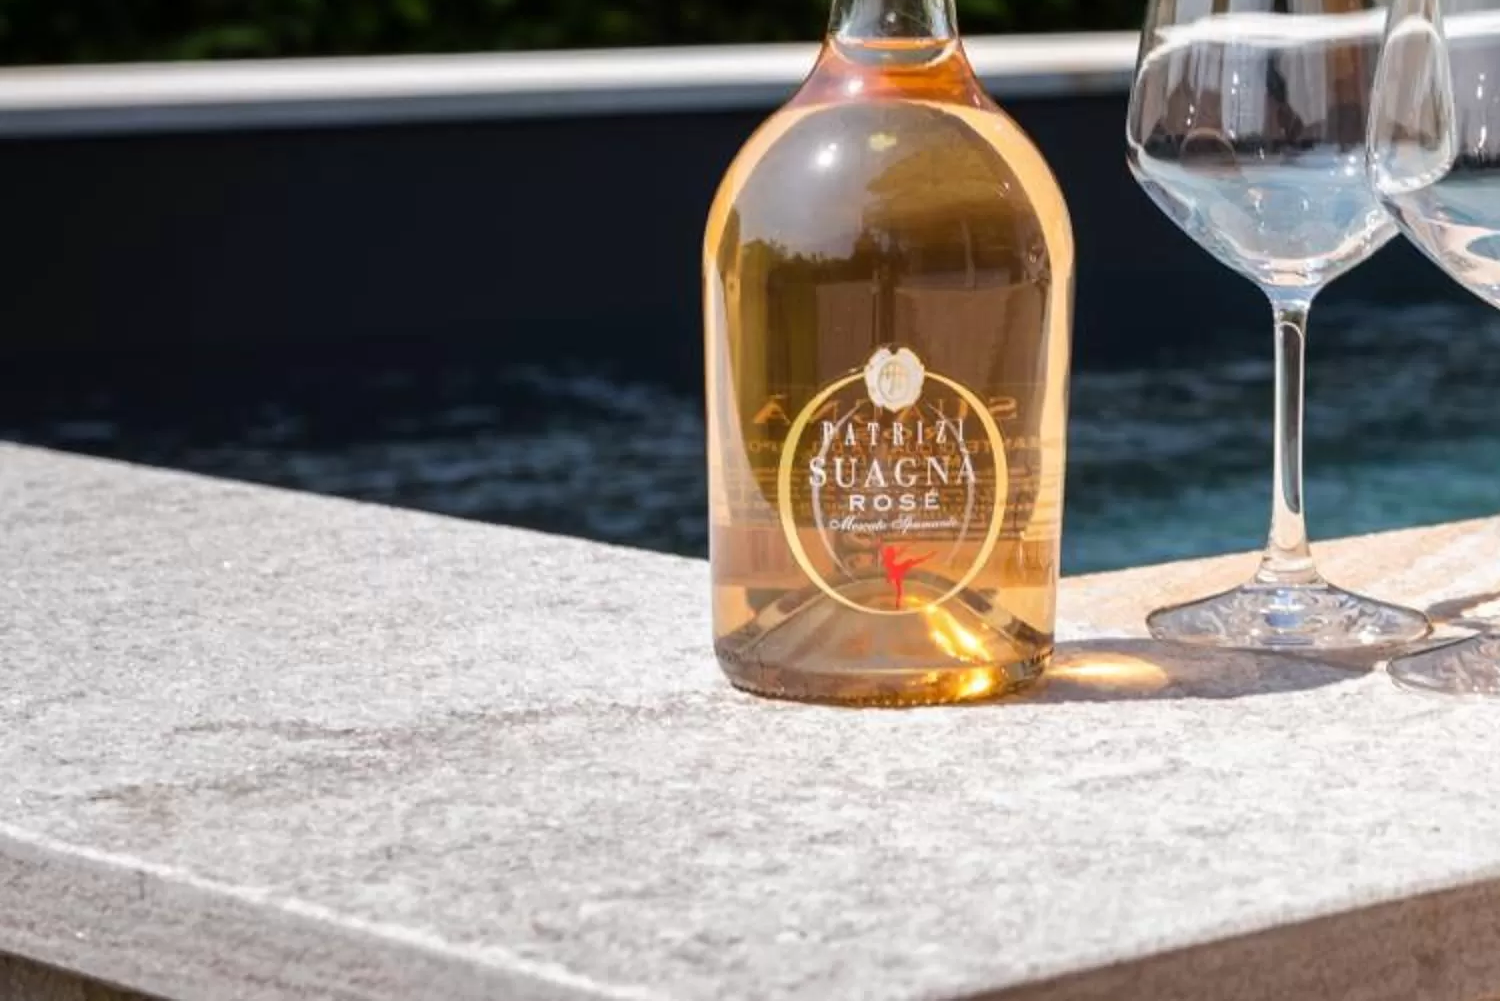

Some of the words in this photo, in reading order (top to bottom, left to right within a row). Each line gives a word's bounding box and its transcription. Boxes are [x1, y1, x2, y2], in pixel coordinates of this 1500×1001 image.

[820, 418, 966, 446] PATRIZI
[848, 487, 941, 512] ROSÉ
[829, 514, 887, 536] Moscato
